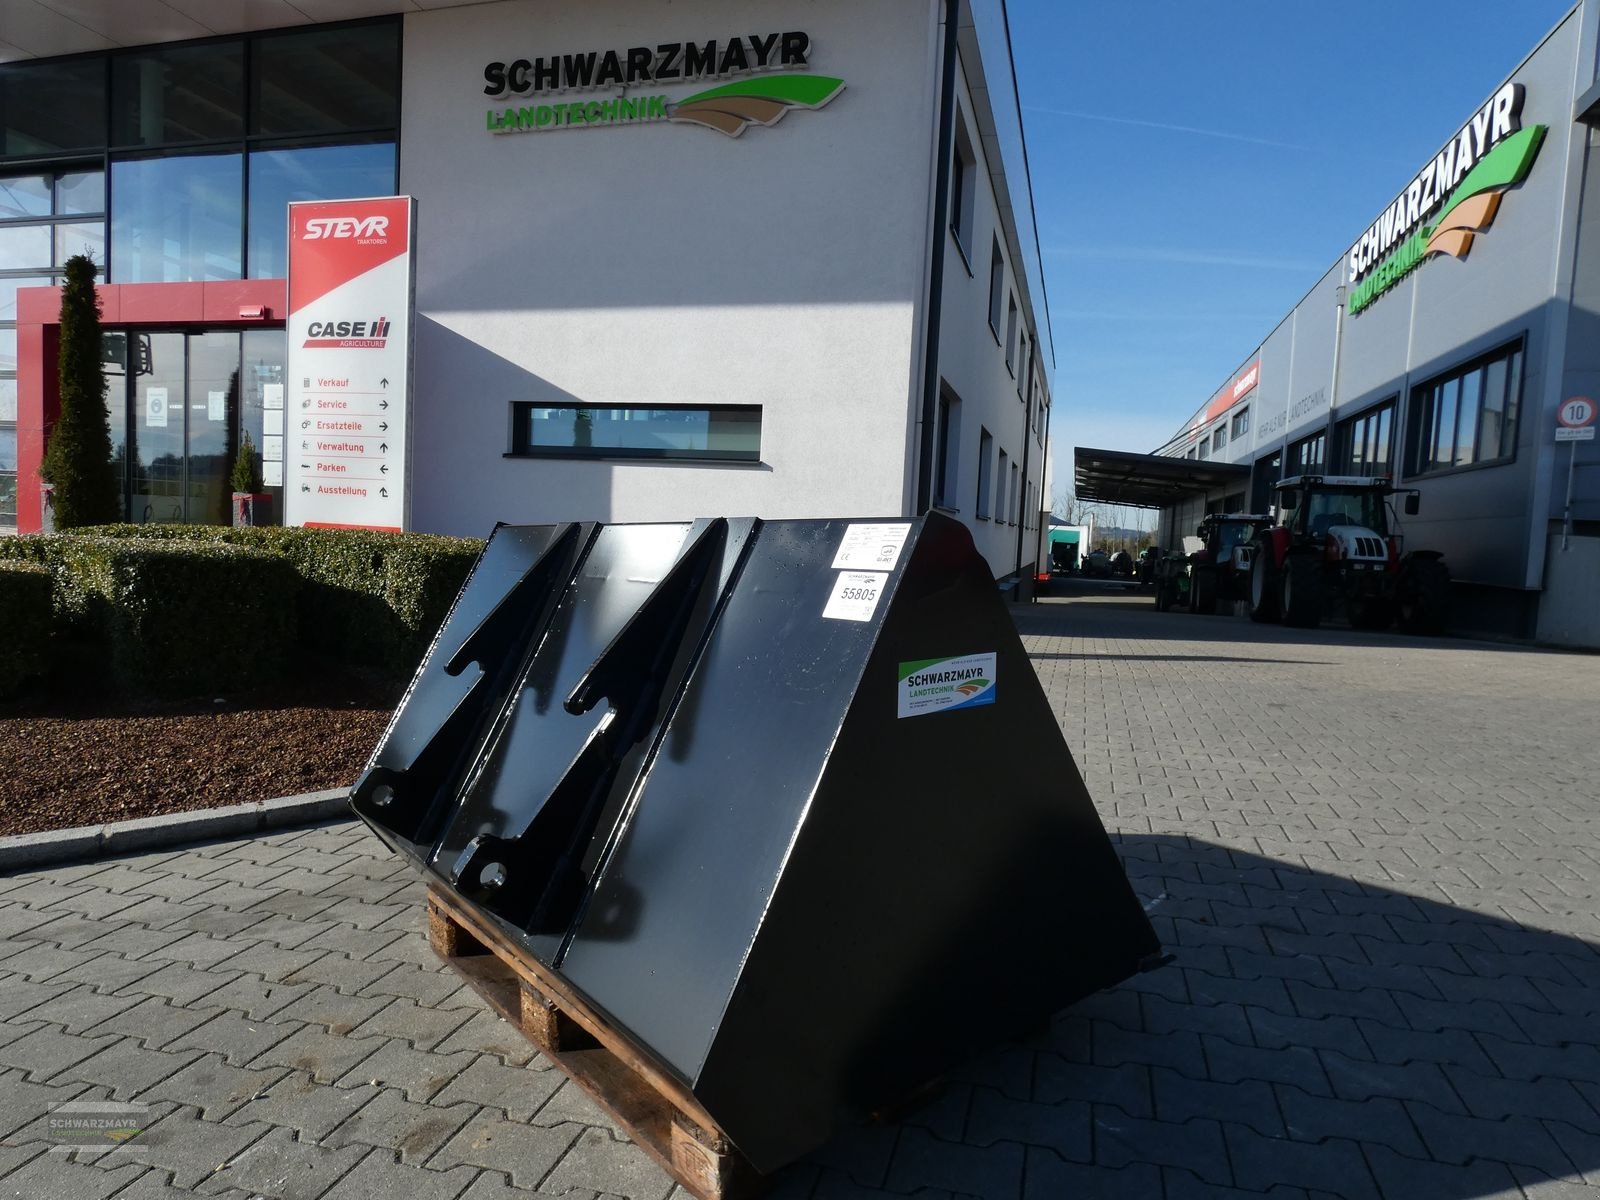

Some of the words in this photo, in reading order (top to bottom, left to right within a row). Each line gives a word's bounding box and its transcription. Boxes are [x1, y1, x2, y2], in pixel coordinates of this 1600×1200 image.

[483, 31, 810, 96] SCHWARZMAYR
[486, 94, 669, 131] LANDTECHNIK
[1349, 82, 1525, 283] SCHWARZMAYR
[303, 215, 389, 240] STEYR
[307, 321, 367, 338] CASE
[340, 340, 384, 348] AGRICULTURE
[317, 378, 349, 387] Verkauf
[317, 400, 347, 409] Service
[1569, 405, 1584, 420] 10
[317, 421, 362, 431] Ersatzteile
[317, 441, 364, 453] Verwaltung
[317, 463, 346, 472] Parken
[317, 485, 367, 497] Ausstellung
[841, 587, 877, 601] 55805
[907, 667, 984, 688] SCHWARZMAYR
[909, 684, 955, 698] LANDTECHNIK
